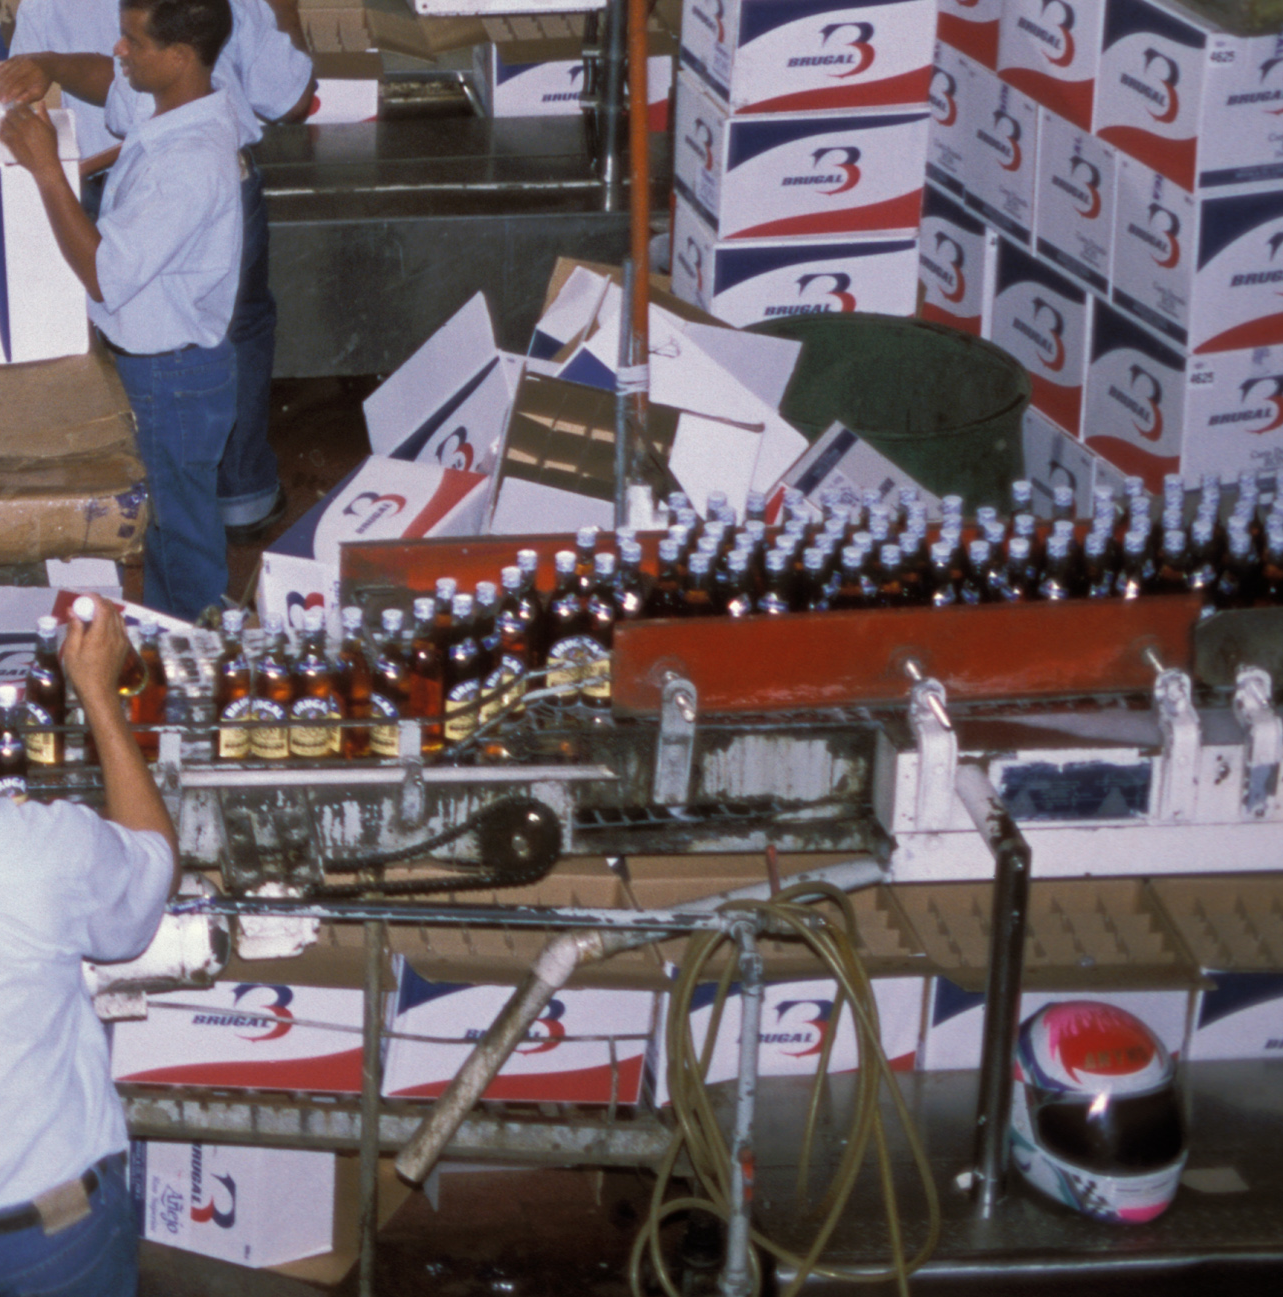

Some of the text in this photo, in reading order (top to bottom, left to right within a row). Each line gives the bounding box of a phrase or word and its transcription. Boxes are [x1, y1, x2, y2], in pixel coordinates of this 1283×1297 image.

[1017, 17, 1063, 50] BRUGAL
[787, 54, 857, 68] BRUGAL
[1119, 71, 1166, 106] BRUGAL
[1226, 90, 1283, 106] BRUGA
[781, 174, 844, 186] BRUGAL
[1230, 269, 1283, 287] BRUG
[763, 304, 833, 317] BRUGAL
[1208, 406, 1274, 426] BRUGAL
[192, 1014, 271, 1028] BRUGAL
[161, 1183, 184, 1235] Añejo
